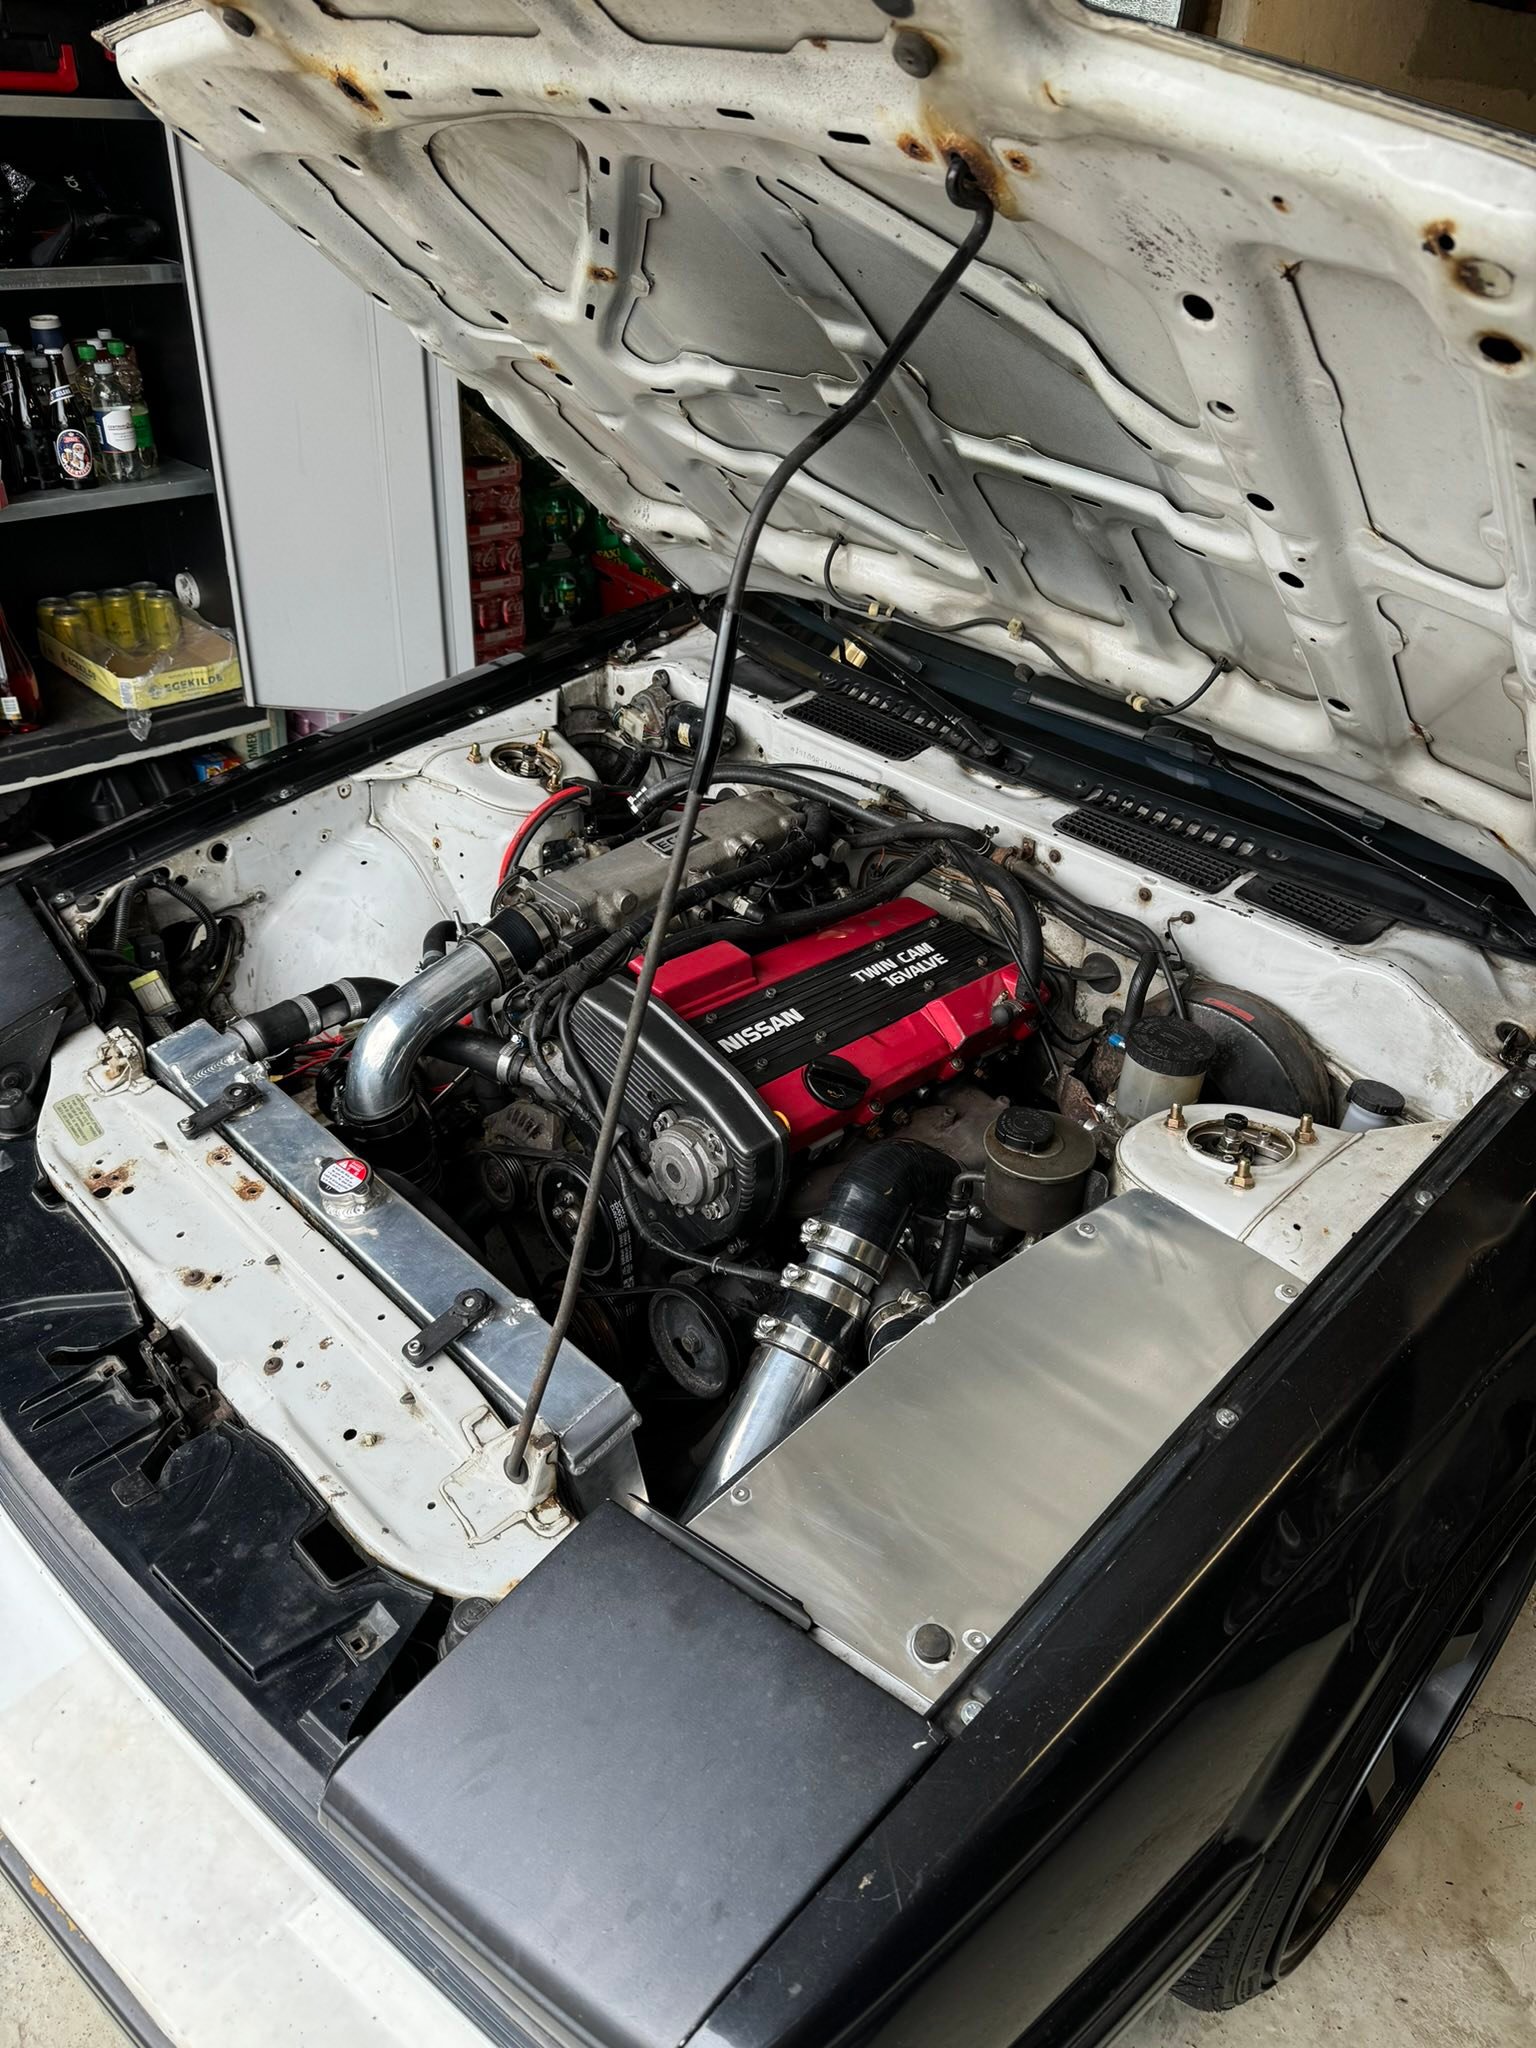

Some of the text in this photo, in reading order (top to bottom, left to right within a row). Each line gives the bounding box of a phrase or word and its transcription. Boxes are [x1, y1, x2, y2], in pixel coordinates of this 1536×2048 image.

[164, 673, 224, 692] EGEKILDE
[850, 941, 936, 984] TWIN CAM
[881, 953, 949, 987] 16VALVE
[716, 1007, 806, 1054] NISSAN
